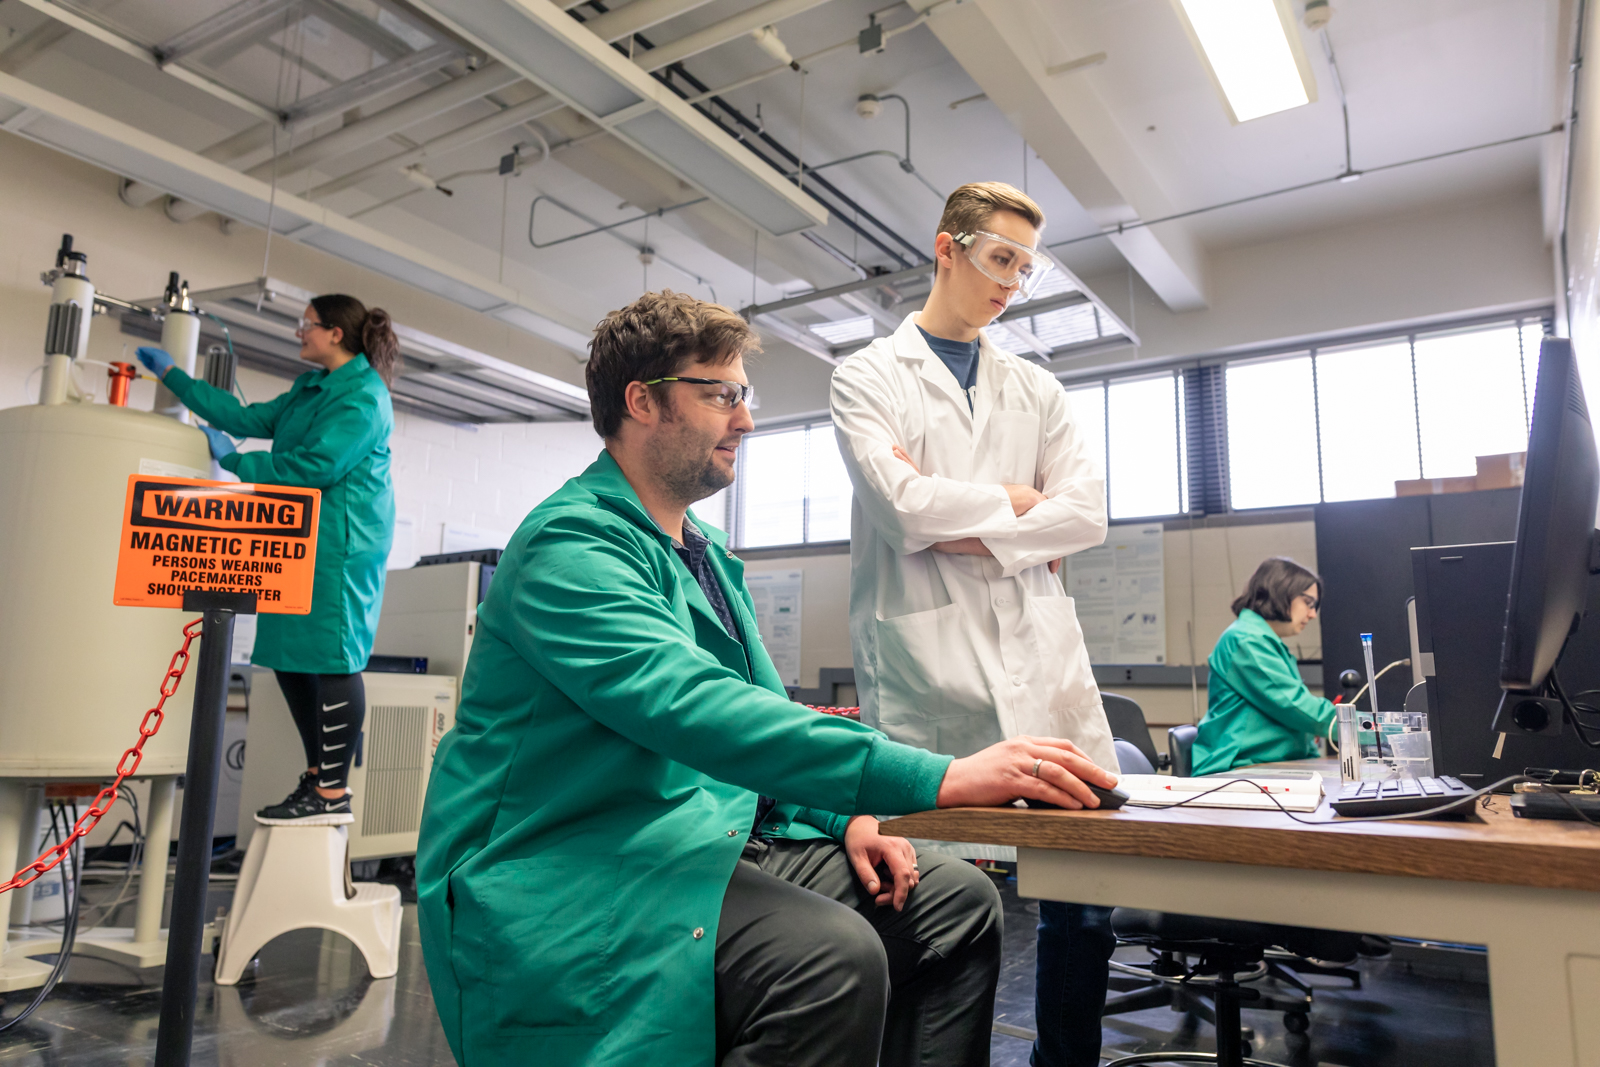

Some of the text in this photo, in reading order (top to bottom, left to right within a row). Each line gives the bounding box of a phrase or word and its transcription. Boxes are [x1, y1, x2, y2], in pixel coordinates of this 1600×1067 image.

[154, 494, 296, 526] WARNING
[130, 531, 307, 560] MAGNETIC FIELD
[152, 555, 283, 574] PERSONS WEARING
[170, 570, 262, 587] PACEMAKERS
